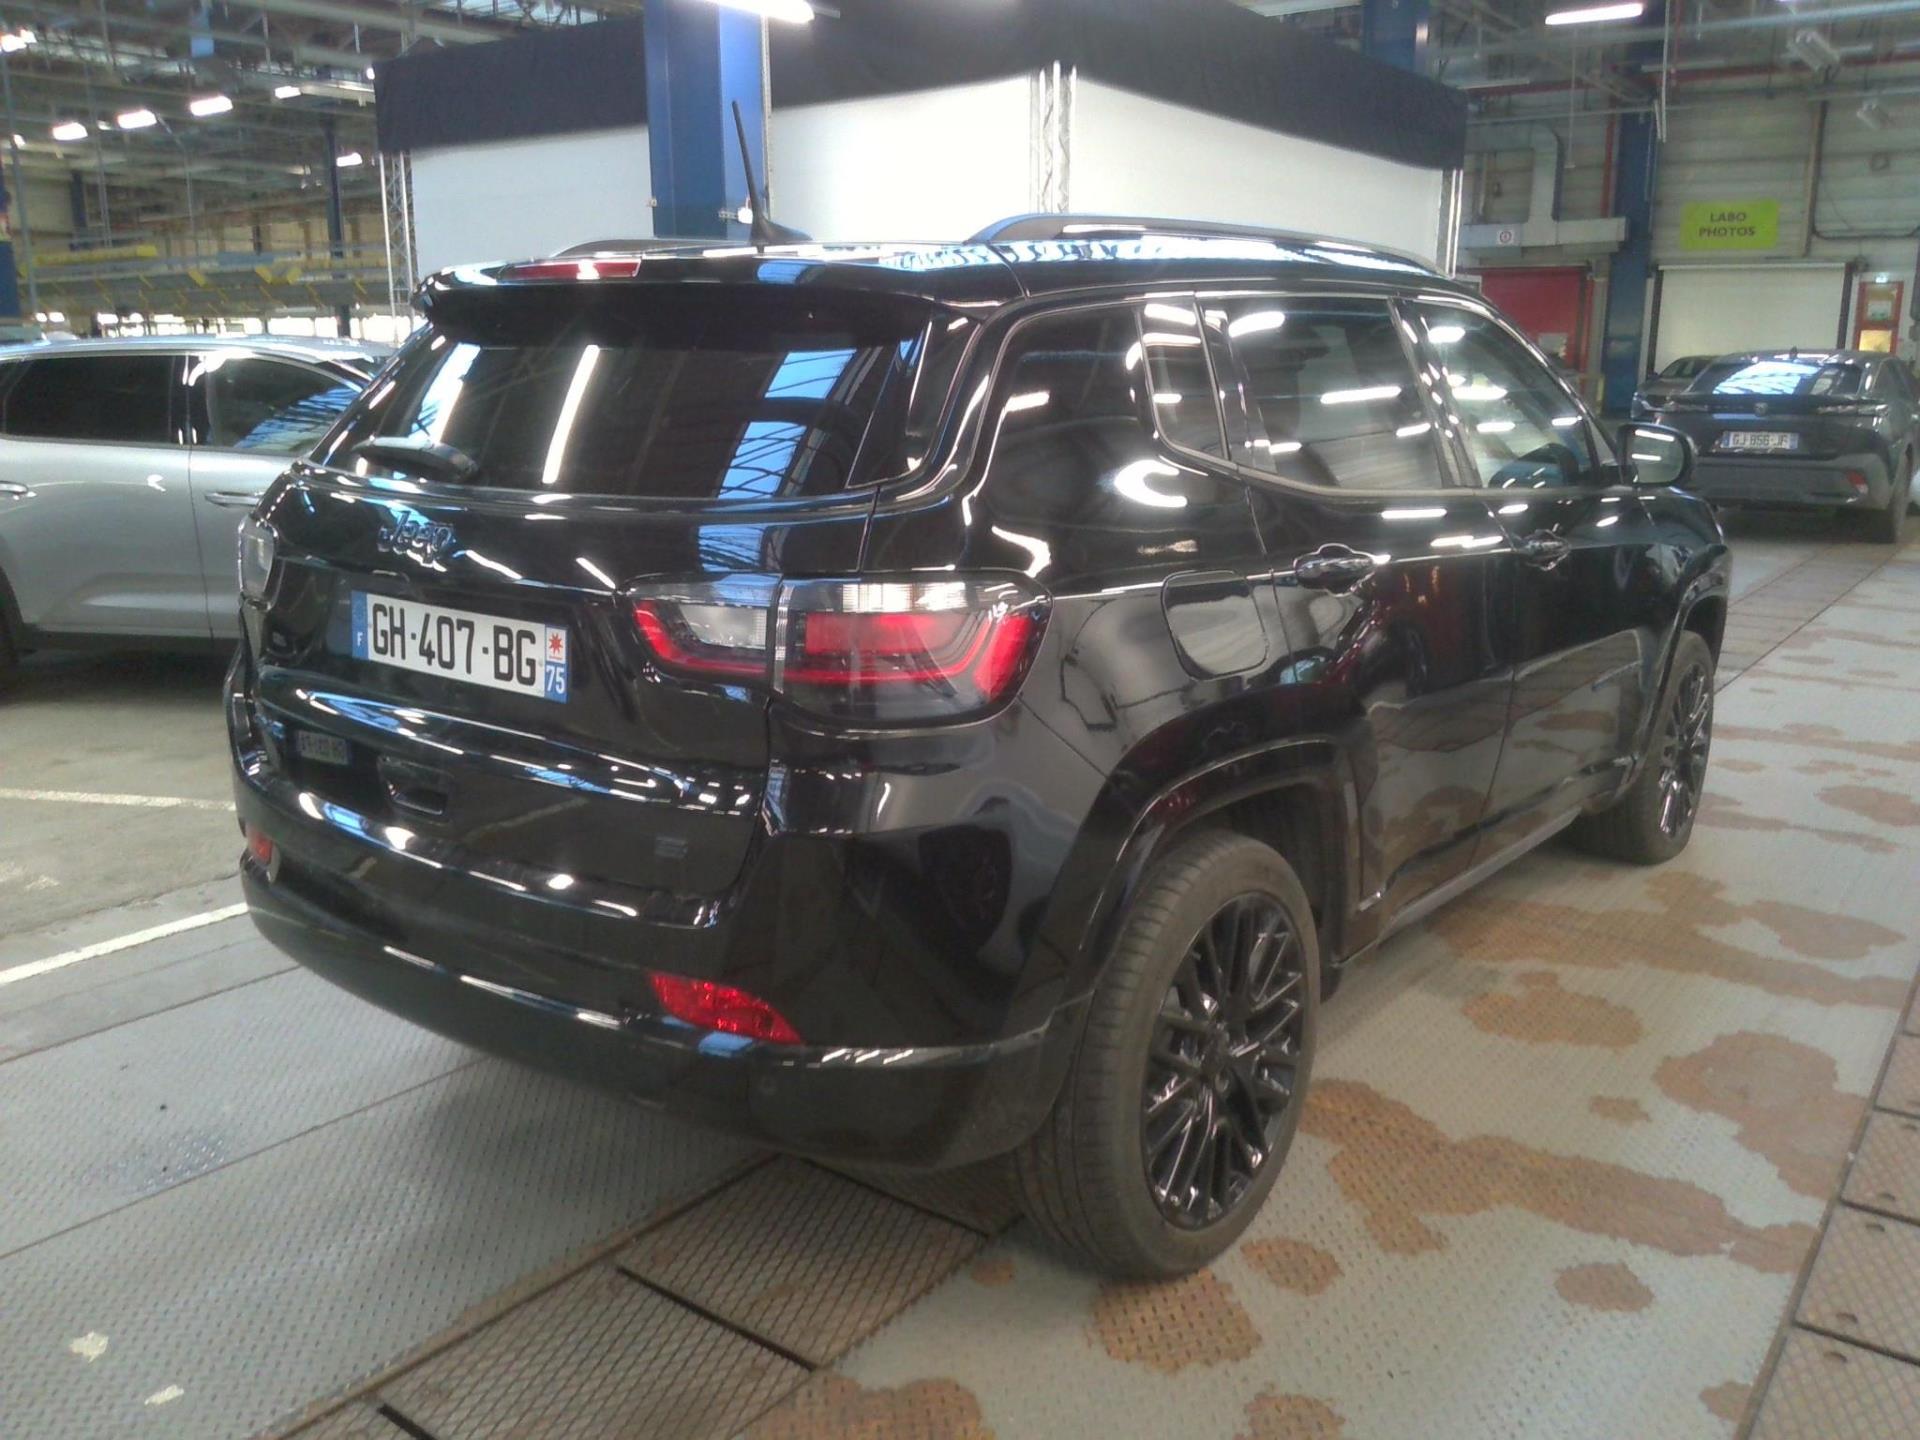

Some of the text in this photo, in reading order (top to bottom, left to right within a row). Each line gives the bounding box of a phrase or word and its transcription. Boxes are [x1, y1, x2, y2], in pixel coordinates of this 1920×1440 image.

[1710, 211, 1747, 222] LABO
[1698, 226, 1756, 238] PHOTOS
[356, 631, 363, 647] F
[546, 664, 565, 694] 75
